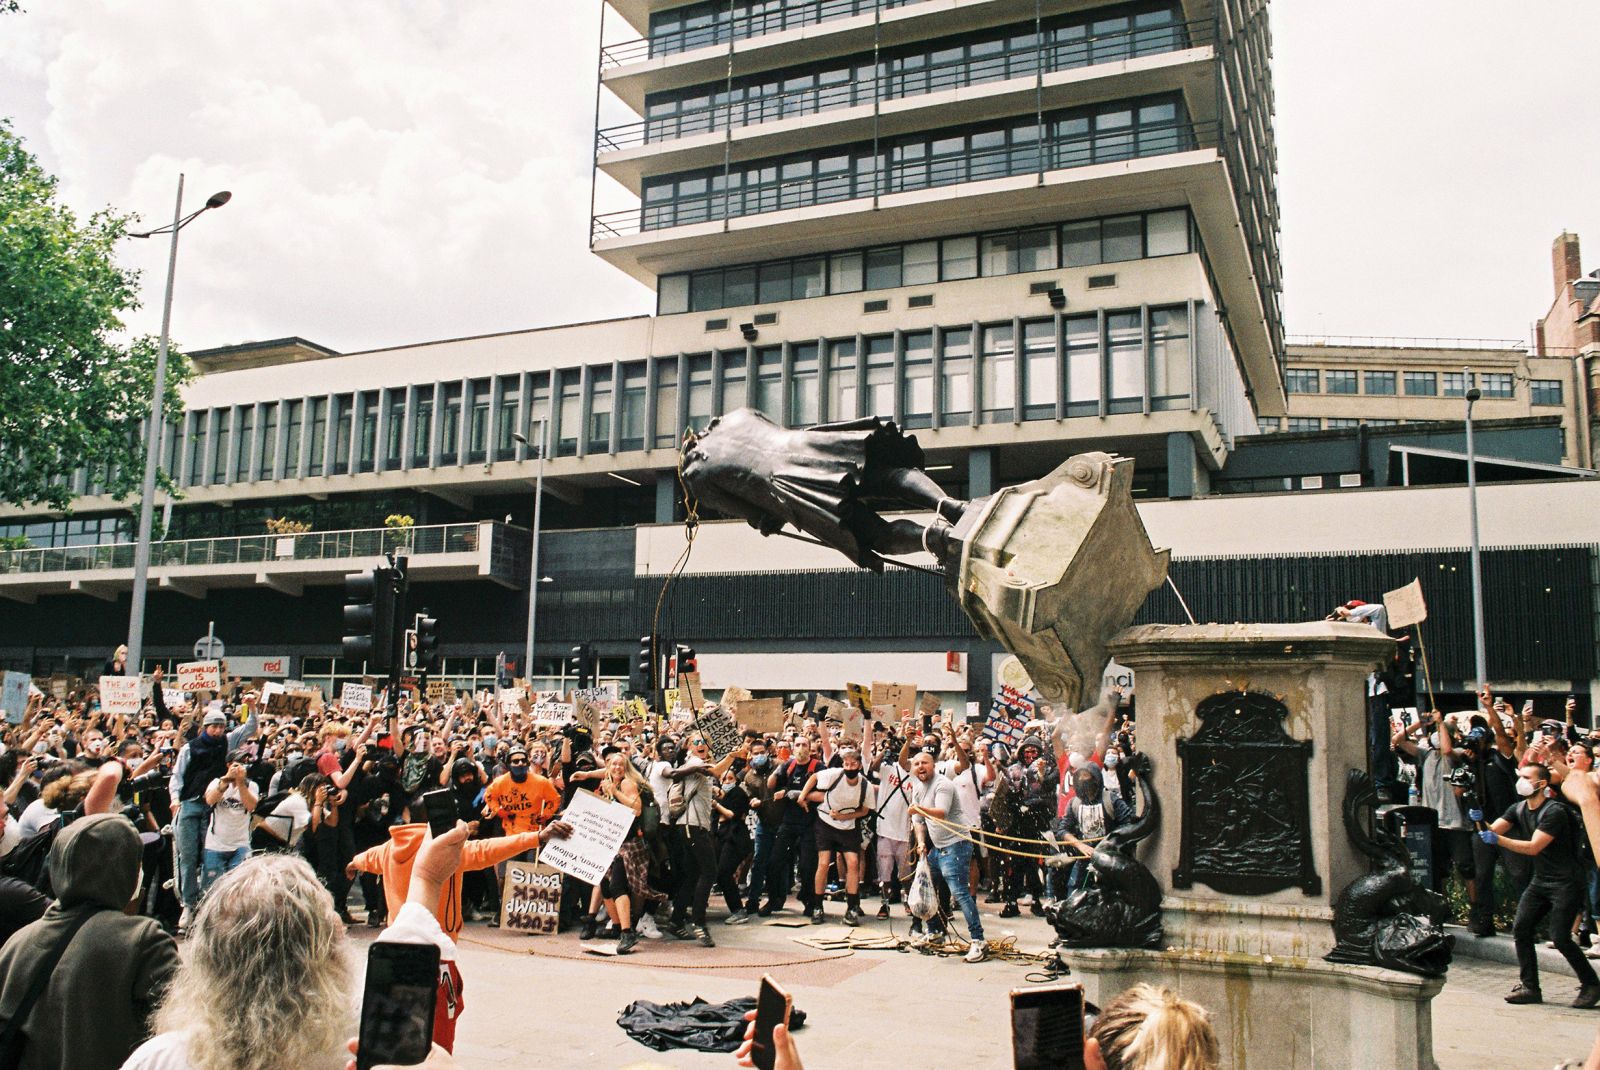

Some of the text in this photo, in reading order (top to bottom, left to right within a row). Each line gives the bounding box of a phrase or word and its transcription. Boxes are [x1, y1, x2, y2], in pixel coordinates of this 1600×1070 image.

[263, 659, 281, 672] red
[105, 680, 121, 689] THE
[182, 681, 217, 691] COOKED
[575, 686, 608, 698] RACISM
[268, 693, 311, 714] BLACK
[511, 868, 561, 889] BORIS
[513, 885, 560, 903] FUCK
[505, 897, 559, 916] TRUMP
[507, 912, 557, 932] FUCK
